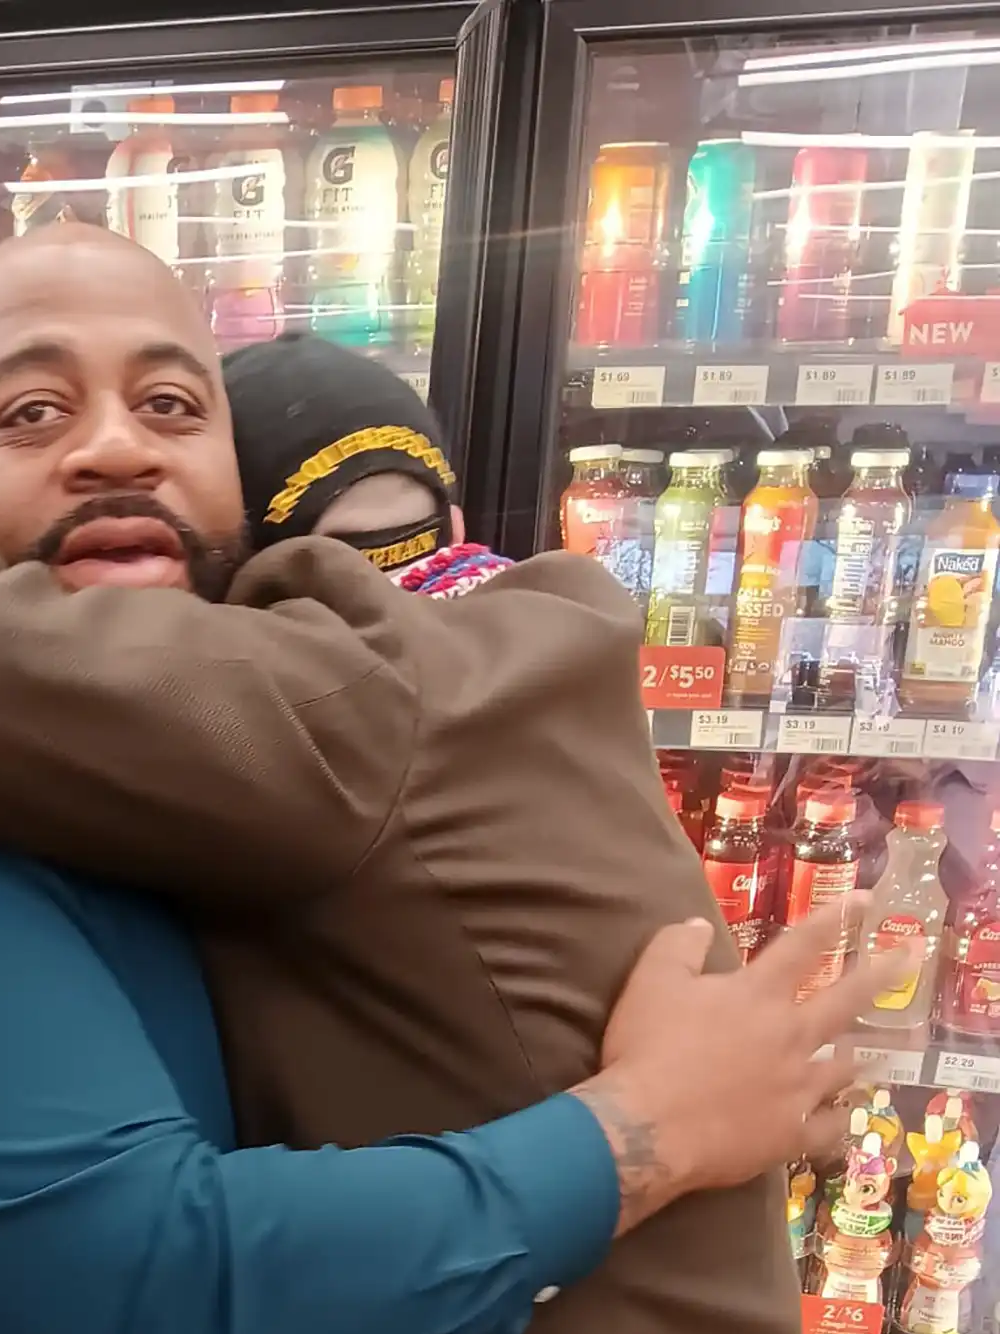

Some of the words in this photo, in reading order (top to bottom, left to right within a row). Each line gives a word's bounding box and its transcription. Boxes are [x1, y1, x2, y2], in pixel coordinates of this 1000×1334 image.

[909, 321, 974, 346] NEW
[937, 556, 980, 572] Naked
[881, 919, 922, 936] Casey's
